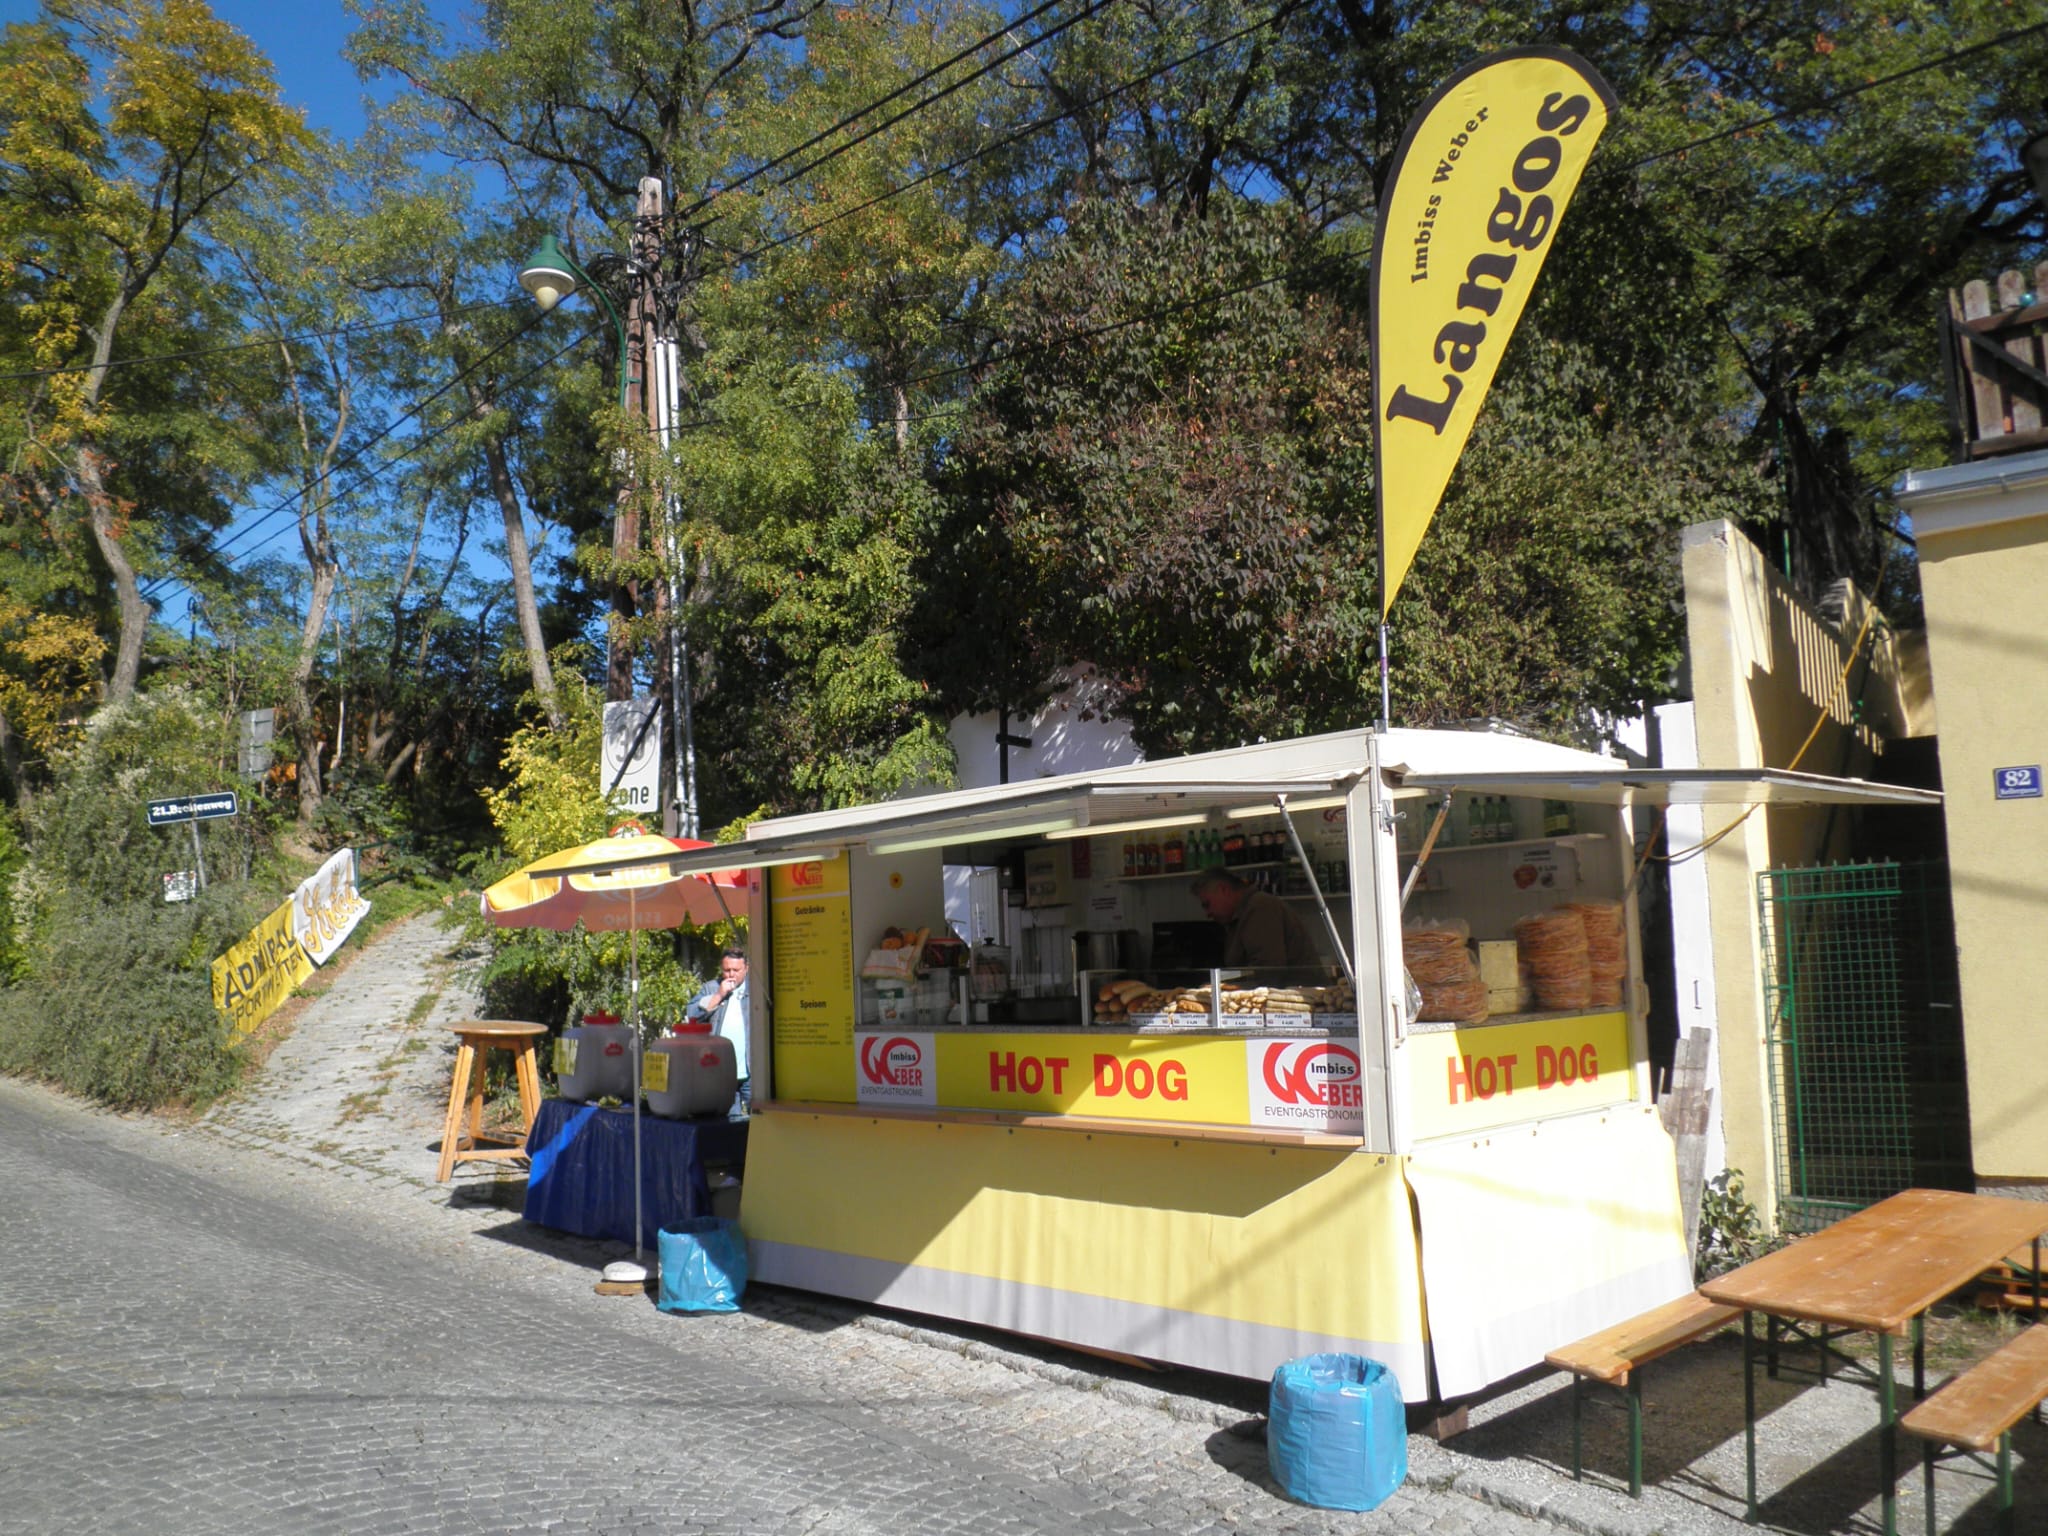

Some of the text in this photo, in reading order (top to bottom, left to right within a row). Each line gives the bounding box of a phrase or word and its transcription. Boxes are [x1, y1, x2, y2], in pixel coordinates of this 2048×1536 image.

[1411, 106, 1490, 284] Imbiss Weber
[1385, 91, 1592, 436] Langos
[2004, 769, 2032, 786] 82
[224, 927, 297, 1009] ADMIRAL
[230, 949, 303, 1027] PORTWETTEN
[890, 1051, 917, 1061] Imbiss
[989, 1051, 1189, 1101] HOT DOG
[1311, 1062, 1355, 1075] Imbiss
[1447, 1043, 1599, 1105] HOT DOG
